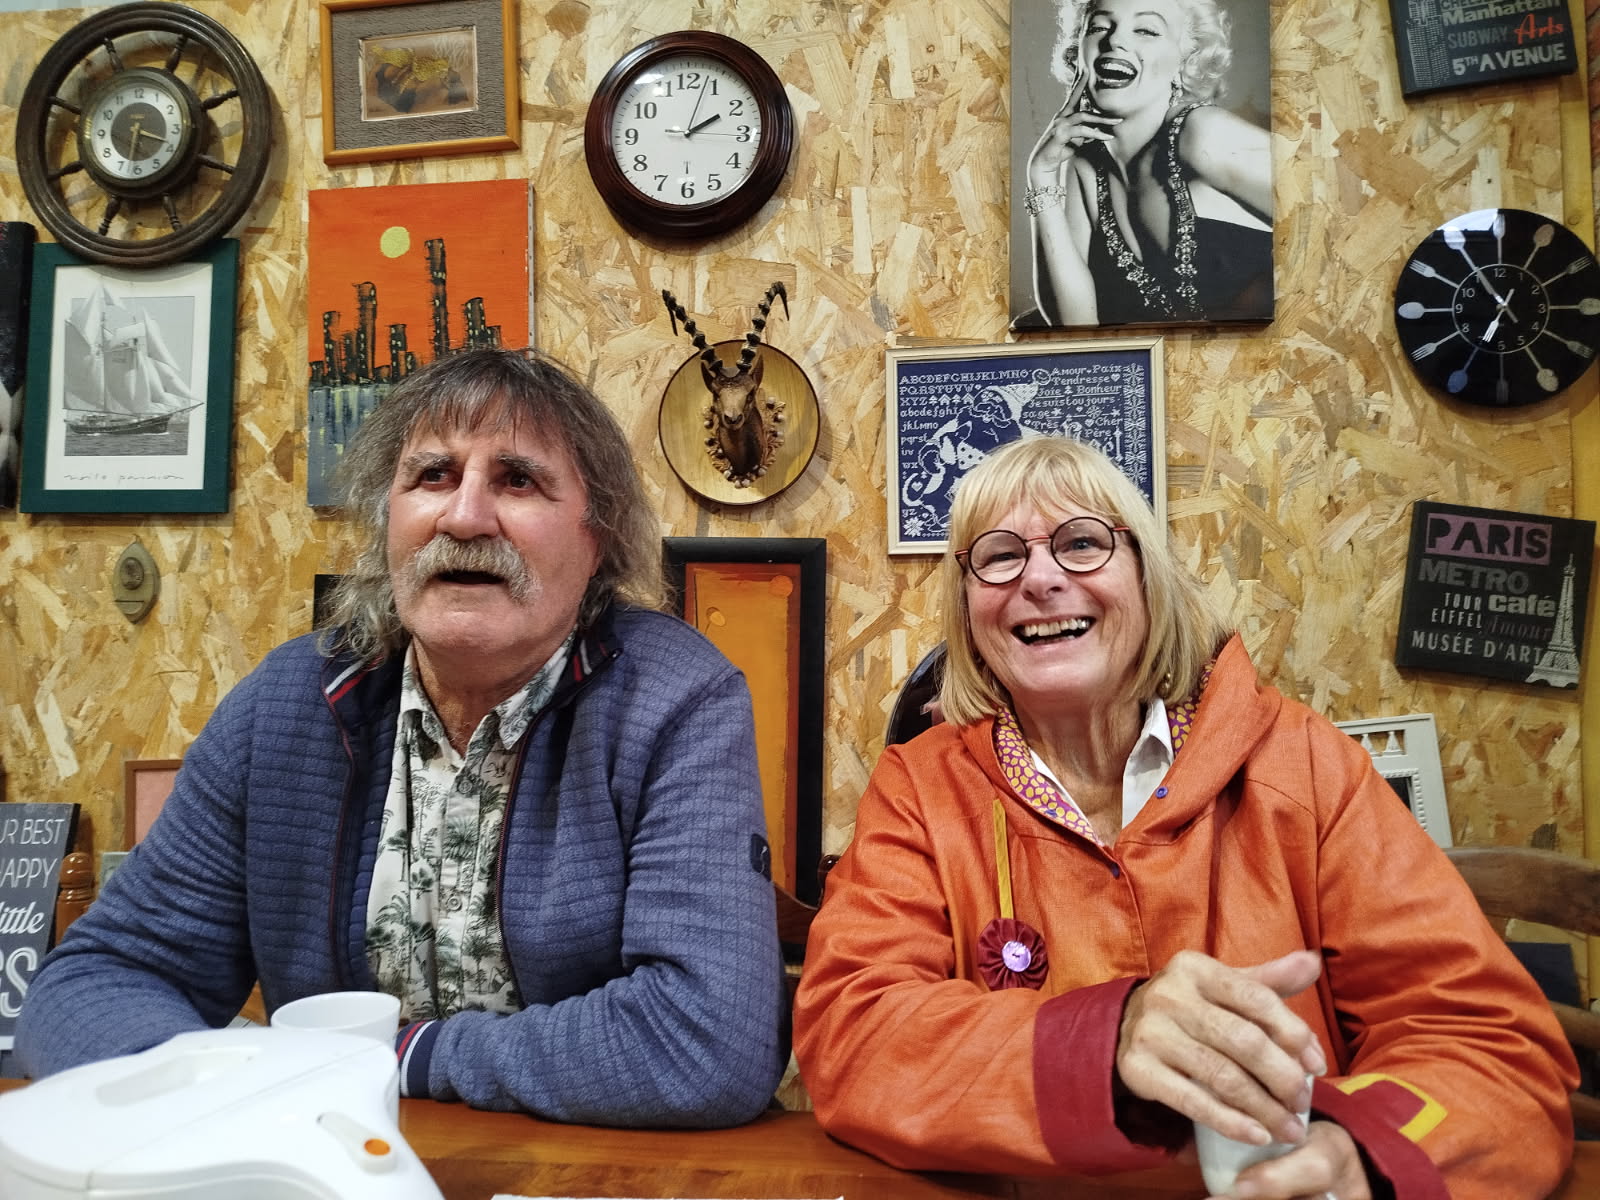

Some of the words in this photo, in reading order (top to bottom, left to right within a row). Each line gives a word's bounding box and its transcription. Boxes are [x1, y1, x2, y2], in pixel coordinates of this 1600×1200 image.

[1442, 0, 1561, 26] Manhattan
[1447, 26, 1508, 49] SUBWAY
[1514, 13, 1564, 45] Arts
[1479, 43, 1567, 72] AVENUE
[676, 72, 701, 90] 12
[654, 80, 673, 97] 11
[711, 79, 720, 96] 1
[134, 88, 145, 99] 12
[155, 93, 160, 102] 1
[116, 96, 124, 105] 11
[166, 104, 175, 115] 2
[634, 101, 657, 119] 10
[729, 99, 744, 117] 2
[103, 109, 114, 120] 10
[97, 129, 106, 139] 9
[171, 123, 180, 135] 3
[736, 125, 751, 142] 3
[624, 128, 639, 145] 9
[102, 147, 112, 158] 8
[165, 144, 174, 153] 4
[117, 161, 124, 171] 7
[152, 159, 161, 169] 5
[633, 154, 648, 172] 8
[725, 152, 742, 169] 4
[133, 165, 142, 175] 6
[654, 174, 668, 192] 7
[707, 173, 722, 191] 5
[680, 181, 695, 199] 6
[1494, 267, 1508, 278] 12
[1519, 273, 1524, 281] 1
[1462, 287, 1475, 298] 10
[1531, 286, 1540, 295] 2
[1455, 304, 1463, 314] 9
[1538, 304, 1546, 314] 3
[1462, 323, 1470, 333] 8
[1531, 321, 1539, 331] 4
[1517, 335, 1525, 346] 5
[1092, 364, 1122, 374] Paix
[1051, 375, 1110, 386] Tendresse
[1076, 384, 1122, 394] Bonheur
[900, 396, 928, 406] XYZ
[1095, 417, 1123, 427] Cher
[1084, 428, 1112, 438] Père
[1428, 518, 1549, 558] PARIS
[1418, 558, 1530, 595] METRO
[1444, 592, 1482, 611] TOUR
[1431, 608, 1482, 629] EIFFEL
[1412, 630, 1473, 655] MUSÉE
[1483, 640, 1544, 665] D'ART
[20, 819, 65, 845] BEST
[0, 946, 37, 1018] S
